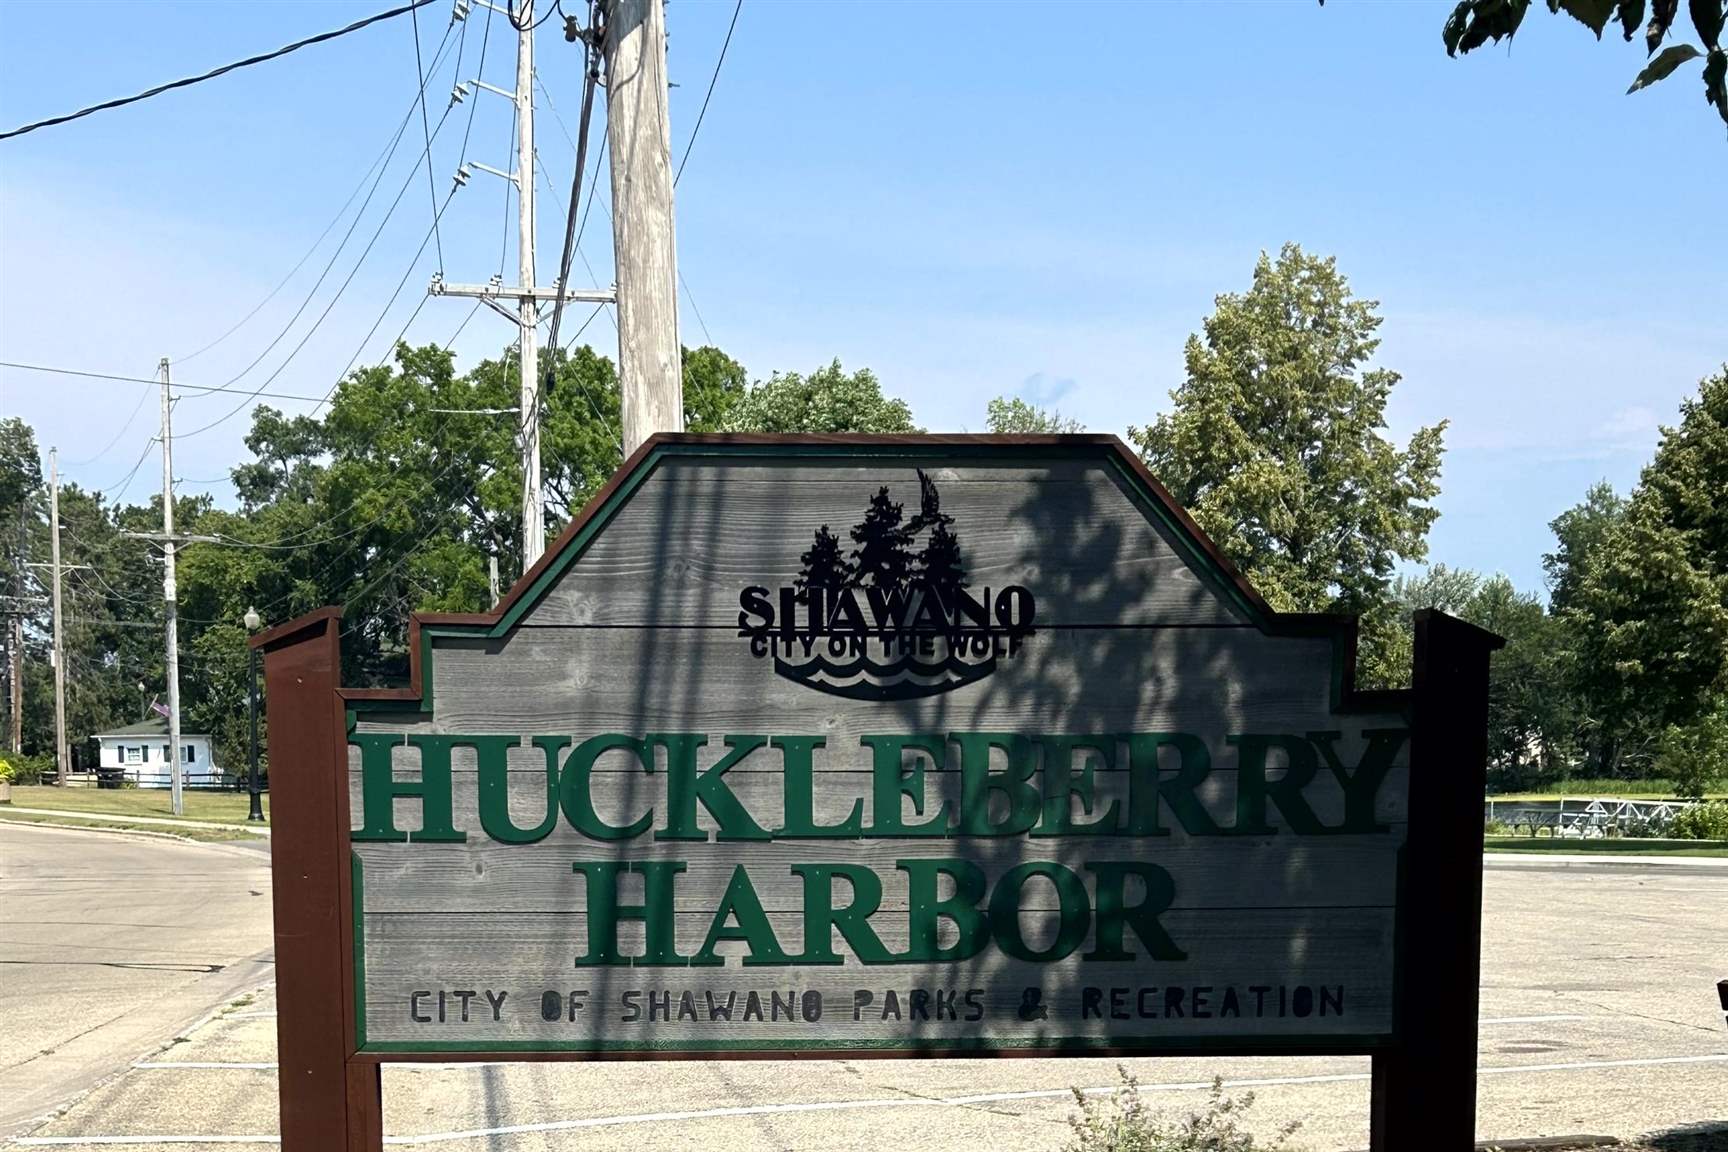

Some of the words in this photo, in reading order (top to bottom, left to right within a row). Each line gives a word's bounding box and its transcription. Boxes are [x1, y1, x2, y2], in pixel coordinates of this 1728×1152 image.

[738, 585, 1036, 634] SHAWANO
[750, 633, 814, 659] CITY
[828, 634, 865, 658] ON
[879, 634, 935, 658] THE
[948, 633, 1024, 658] WOLF
[347, 727, 1412, 845] HUCKLEBERRY
[572, 858, 1188, 967] HARBOR
[410, 990, 508, 1023] CITY
[541, 990, 590, 1023] OF
[621, 990, 823, 1023] SHAWANO
[854, 988, 985, 1022] PARKS
[1017, 986, 1049, 1023] &
[1081, 984, 1345, 1021] RECREATION
